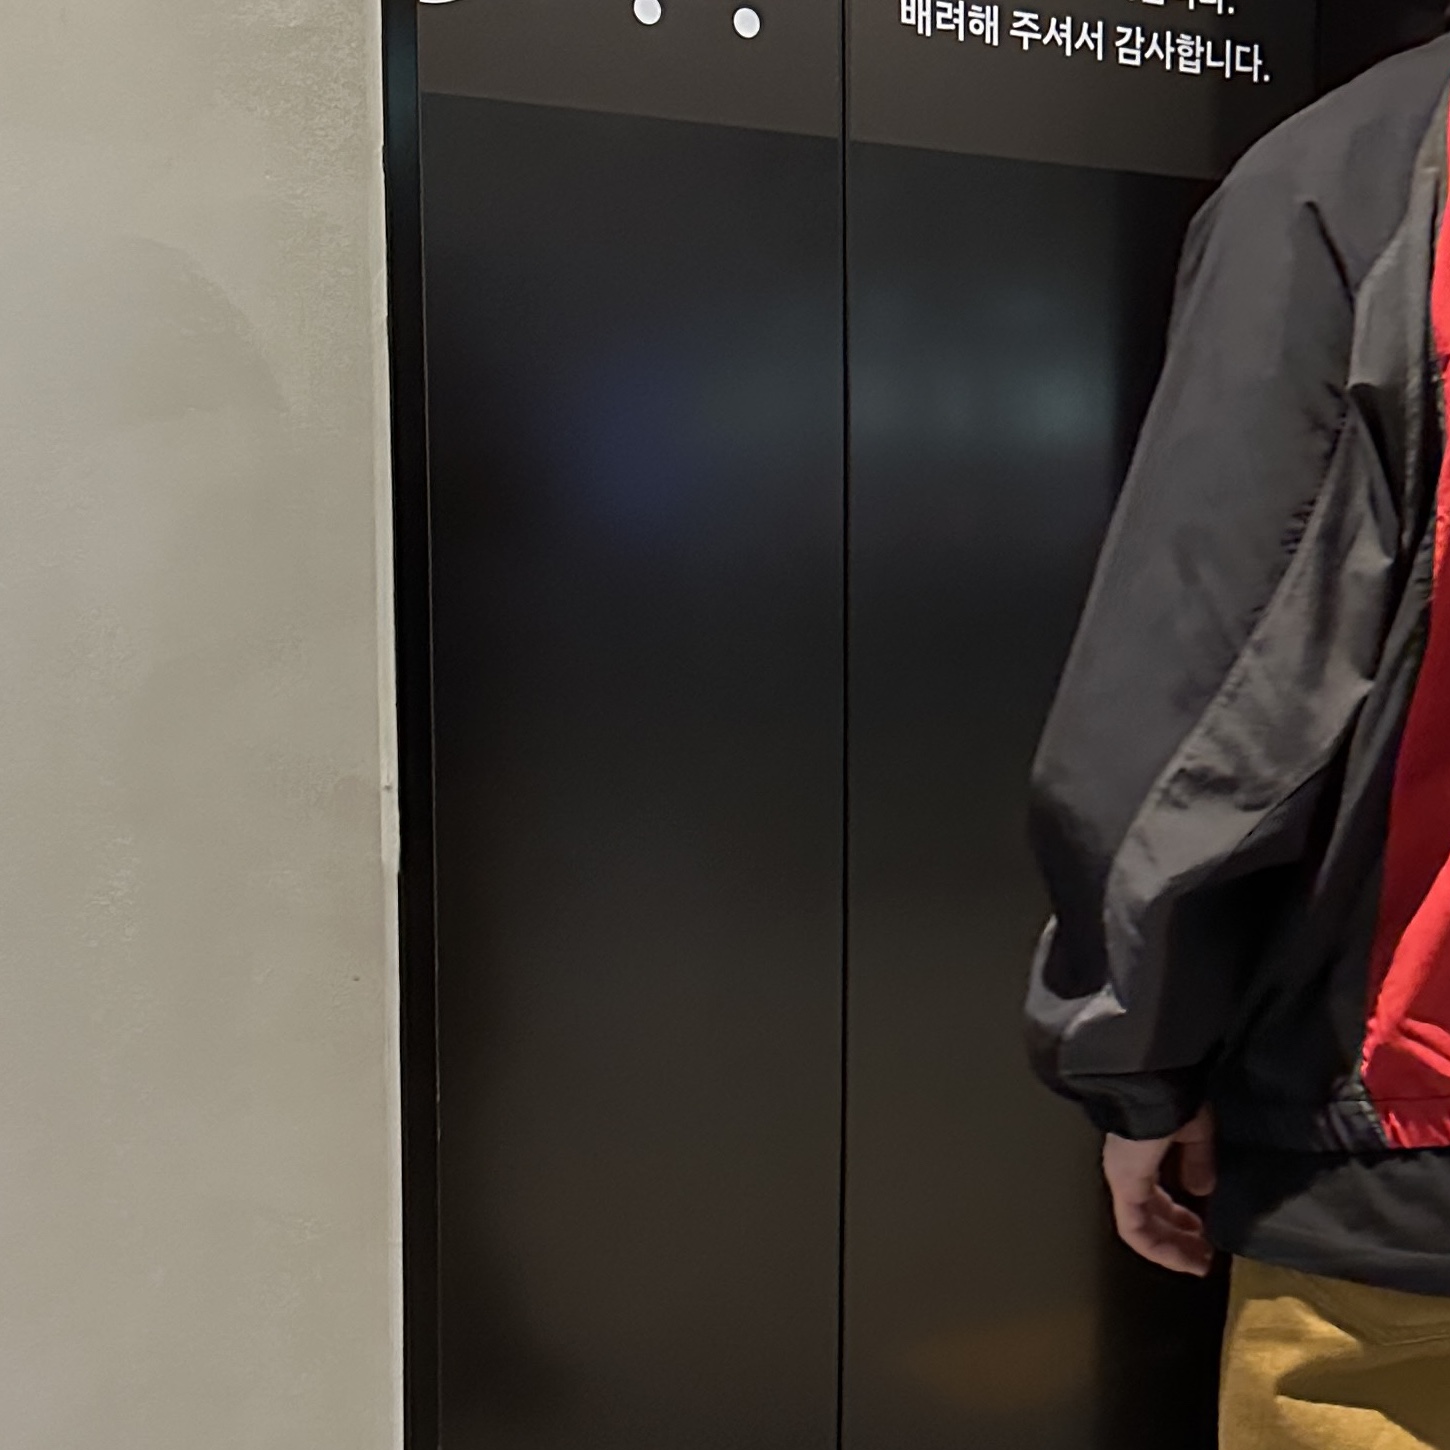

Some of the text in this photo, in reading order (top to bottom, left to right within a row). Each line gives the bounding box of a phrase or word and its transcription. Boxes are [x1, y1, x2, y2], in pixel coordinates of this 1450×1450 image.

[900, 0, 1271, 83] 배려해 주셔서 감사합니다.
